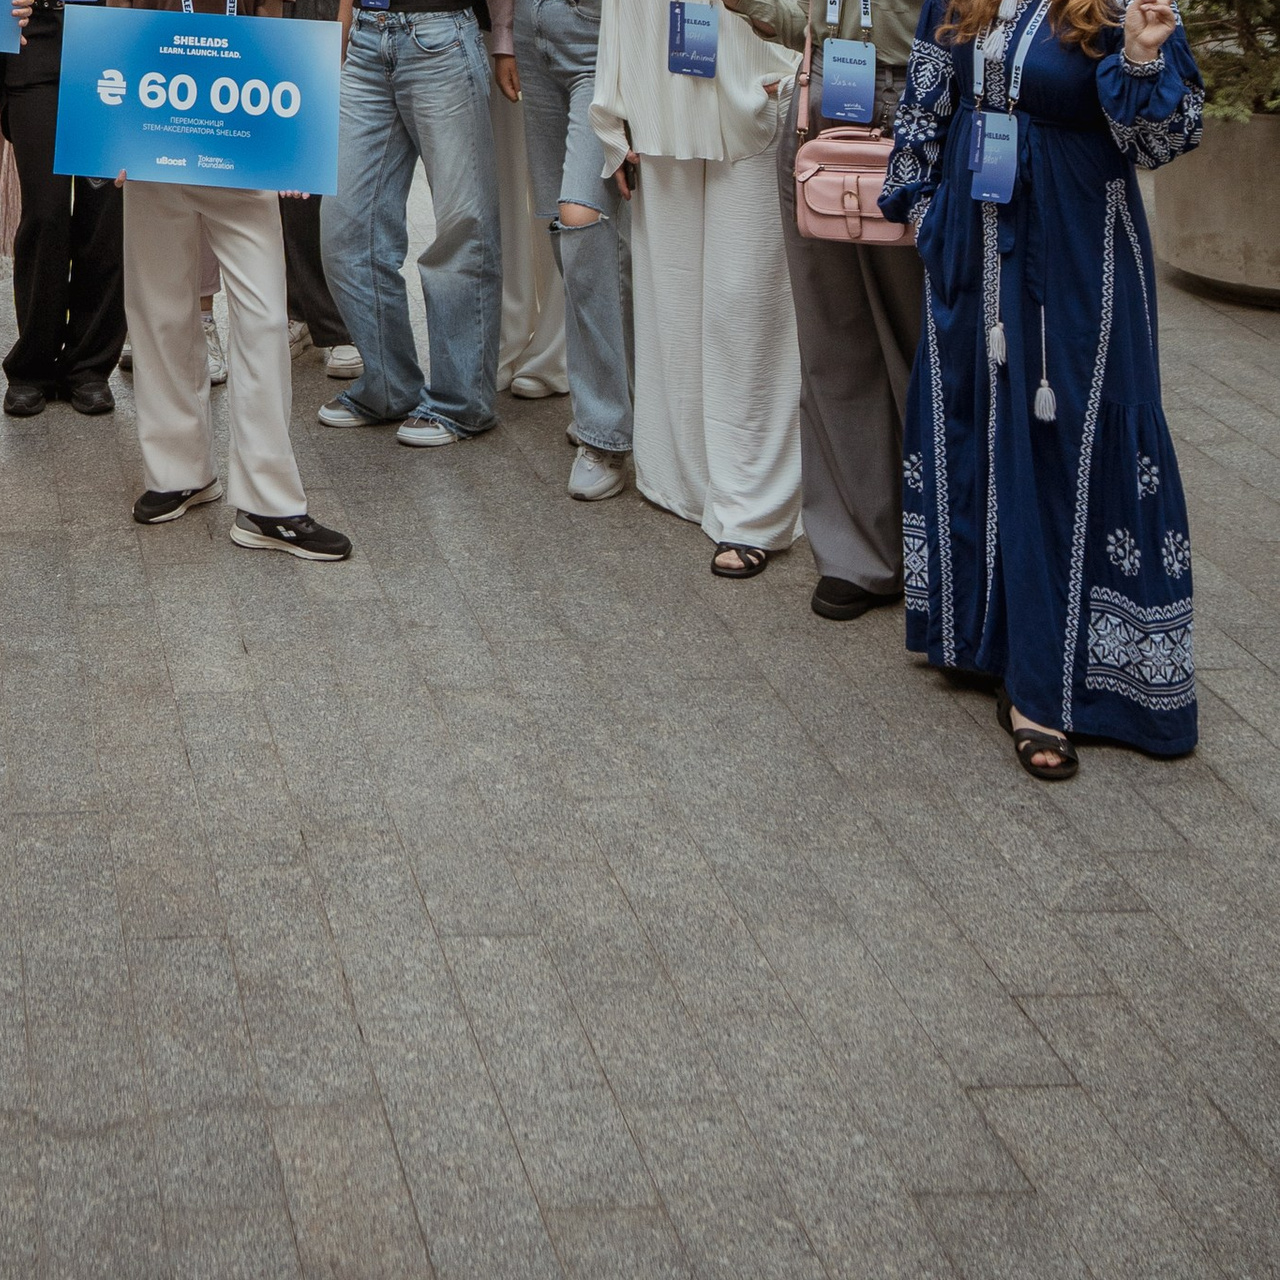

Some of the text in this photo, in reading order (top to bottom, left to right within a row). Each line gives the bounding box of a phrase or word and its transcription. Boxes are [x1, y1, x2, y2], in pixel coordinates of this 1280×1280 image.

[173, 35, 228, 48] SHELEADS
[159, 46, 241, 59] LEARN. LAUNCH. LEAD.
[832, 56, 867, 66] SHELEADS
[97, 69, 302, 118] ₴ 60 000
[170, 116, 224, 128] ПЕРЕМОЖНИЦЯ
[142, 123, 251, 139] STEM-АКСЕЛЕРАТОРА SHELEADS
[985, 132, 1010, 141] HELEADS
[156, 156, 187, 167] uBoost
[198, 155, 224, 164] Tokarev
[198, 162, 234, 170] Foundation
